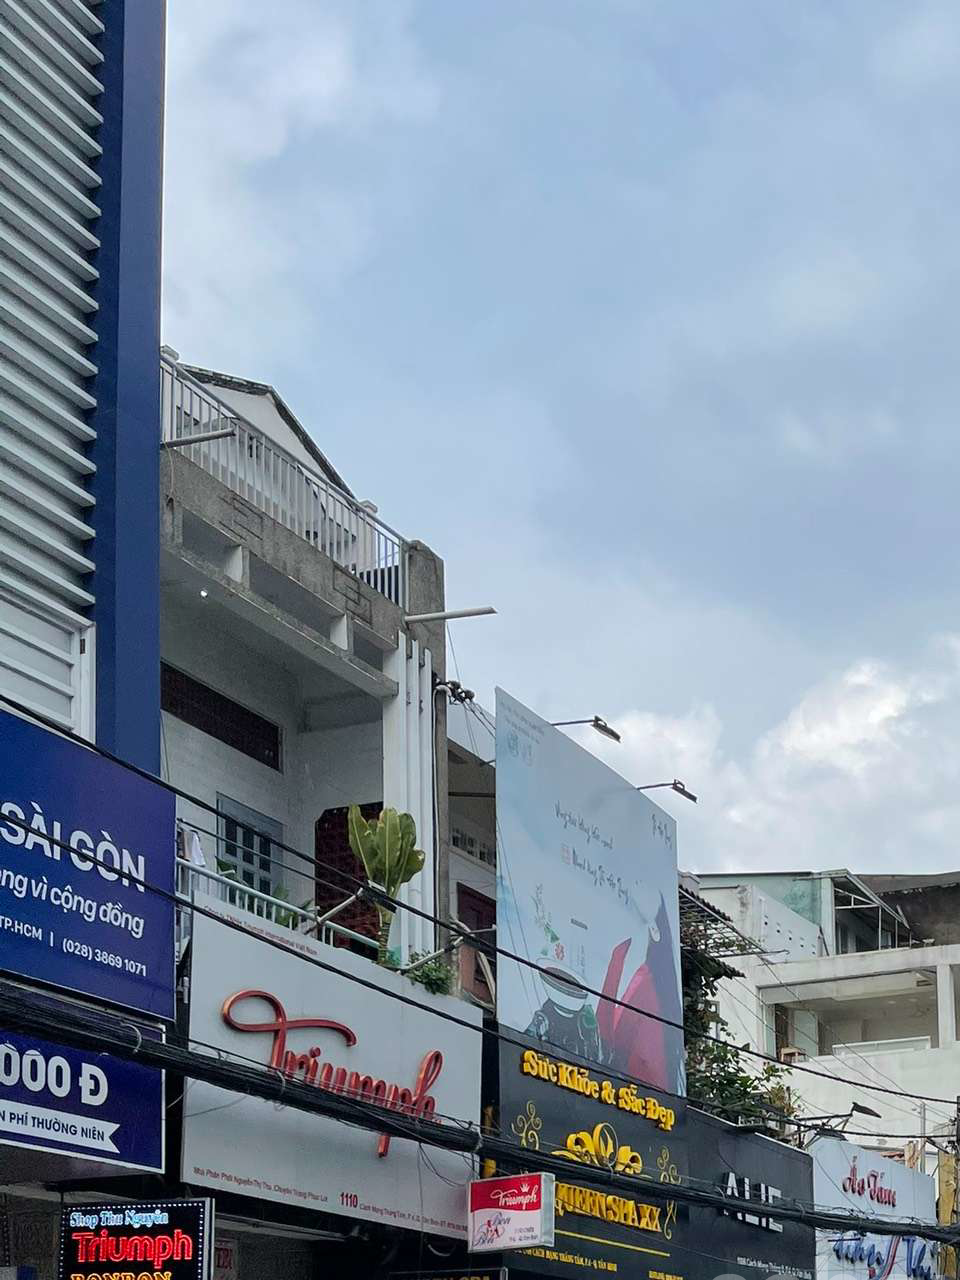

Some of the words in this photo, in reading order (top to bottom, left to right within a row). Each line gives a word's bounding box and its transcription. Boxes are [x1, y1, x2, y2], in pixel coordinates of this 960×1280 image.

[0, 801, 61, 861] SÀI
[69, 830, 145, 893] GÒN
[31, 876, 47, 900] vì
[50, 885, 97, 922] cộng
[99, 902, 144, 939] đồng
[62, 938, 93, 961] (028)
[94, 948, 122, 969] 3869
[123, 958, 147, 977] 1071
[78, 1062, 109, 1106] Đ
[601, 1080, 616, 1105] &
[9, 1112, 28, 1126] PHÍ
[31, 1116, 78, 1137] THƯỜNG
[80, 1125, 105, 1142] NIÊN
[340, 1191, 359, 1208] 1110
[490, 1184, 539, 1210] Triumph
[722, 1171, 783, 1233] ALIE
[70, 1211, 99, 1229] Shop
[100, 1211, 123, 1226] Thu
[72, 1228, 193, 1270] Triumph
